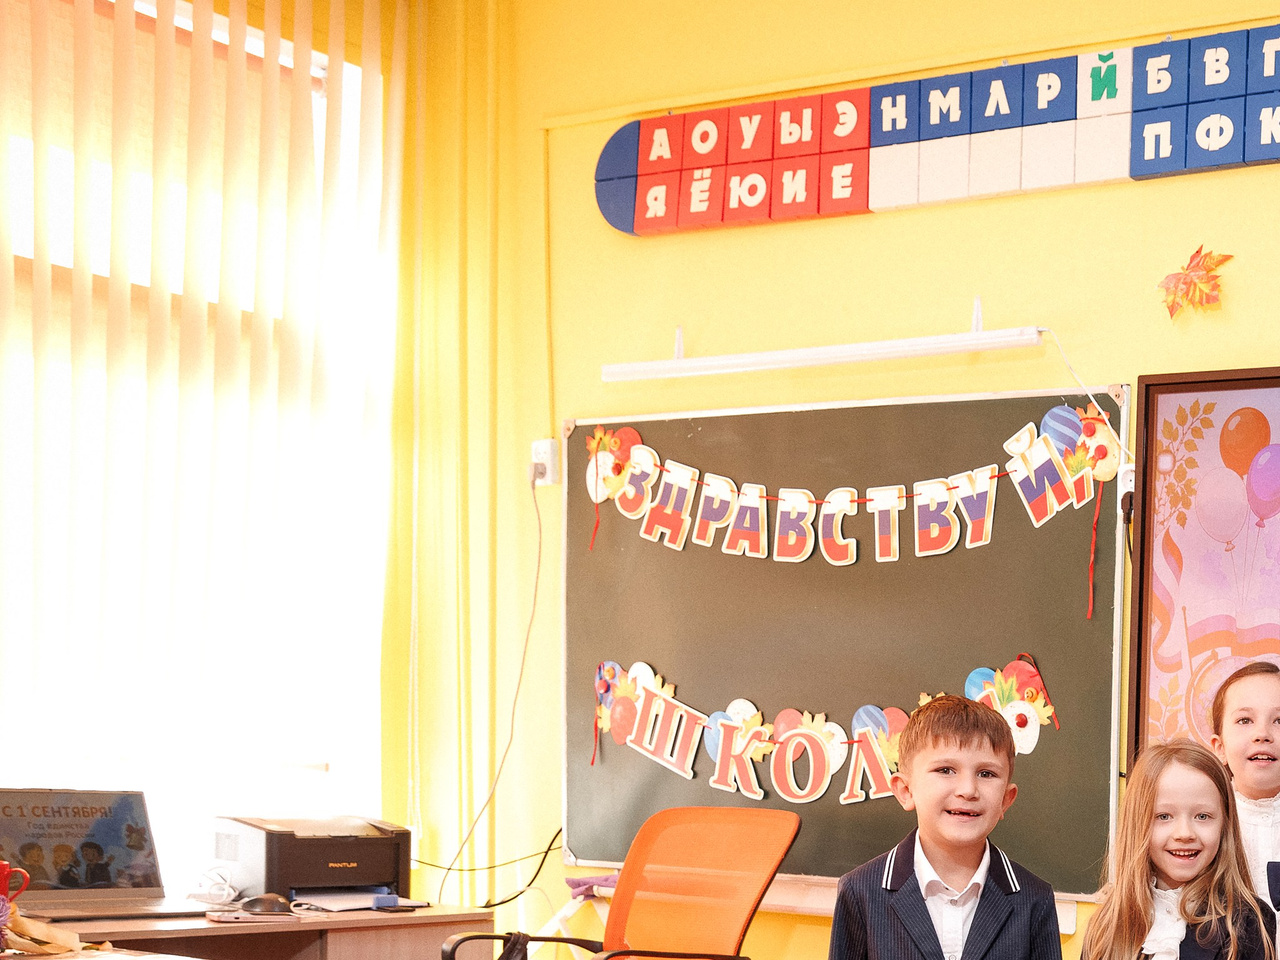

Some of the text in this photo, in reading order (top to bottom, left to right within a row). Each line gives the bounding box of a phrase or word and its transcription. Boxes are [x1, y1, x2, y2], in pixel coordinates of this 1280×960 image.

[649, 127, 670, 160] А
[740, 114, 760, 148] У
[780, 107, 811, 145] Ы
[833, 100, 857, 137] Э
[880, 95, 907, 131] Н
[928, 86, 961, 124] М
[984, 79, 1010, 116] Л
[1036, 72, 1060, 108] Р
[1090, 51, 1118, 101] Й
[1145, 54, 1171, 94] Б
[1203, 46, 1229, 85] В
[645, 185, 666, 217] Я
[690, 168, 711, 212] Ё
[729, 171, 767, 207] Ю
[782, 169, 806, 203] И
[832, 163, 853, 198] Е
[1142, 120, 1172, 160] П
[1195, 113, 1233, 151] Ф
[614, 421, 1096, 566] ЗДРАВСТВУЙ,
[627, 686, 1001, 804] ШКОЛ
[2, 805, 113, 818] С 1 СЕНТЯБРЯ!
